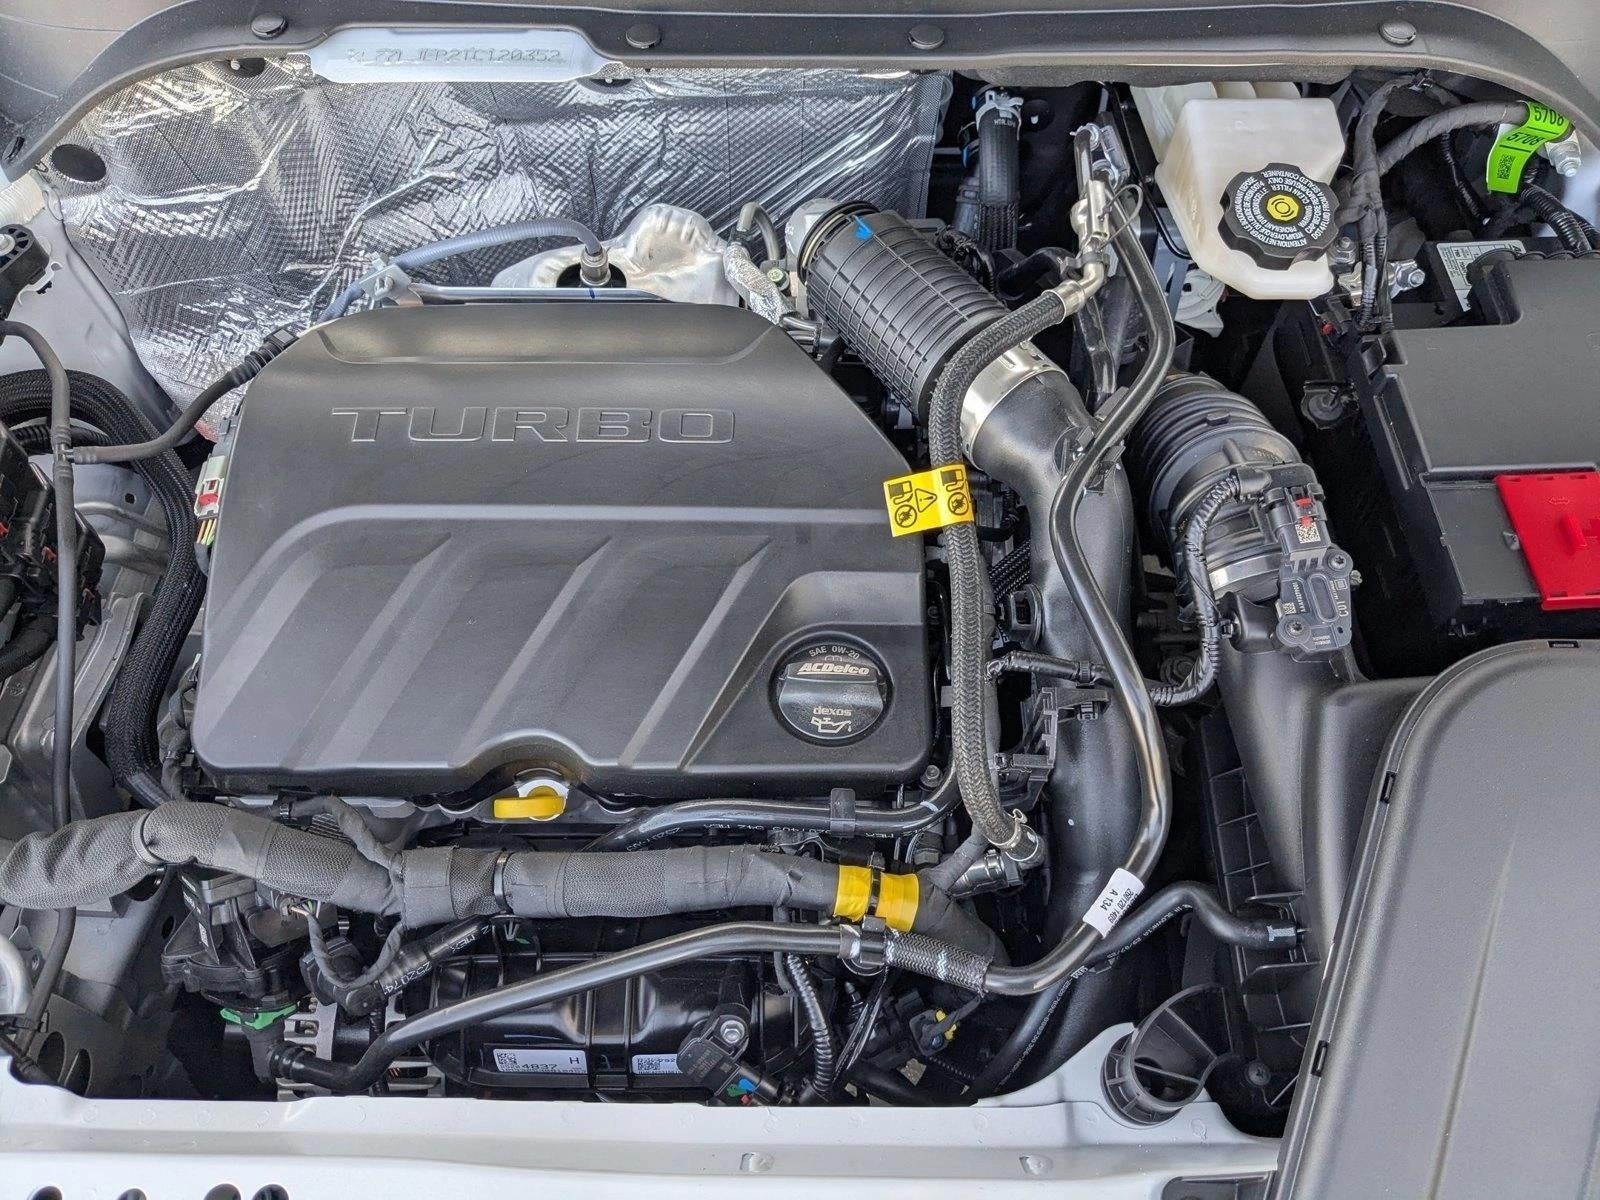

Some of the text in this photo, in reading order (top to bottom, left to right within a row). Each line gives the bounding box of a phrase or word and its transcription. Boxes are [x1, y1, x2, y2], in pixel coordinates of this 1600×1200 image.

[1271, 184, 1292, 192] FILLER
[1299, 177, 1320, 193] SEALED
[1292, 189, 1309, 204] CLEAN
[332, 407, 735, 443] TURBO
[809, 646, 860, 660] SAE 0W-20
[799, 662, 870, 675] ACDelco
[813, 706, 852, 716] dexos
[1100, 897, 1113, 911] 134
